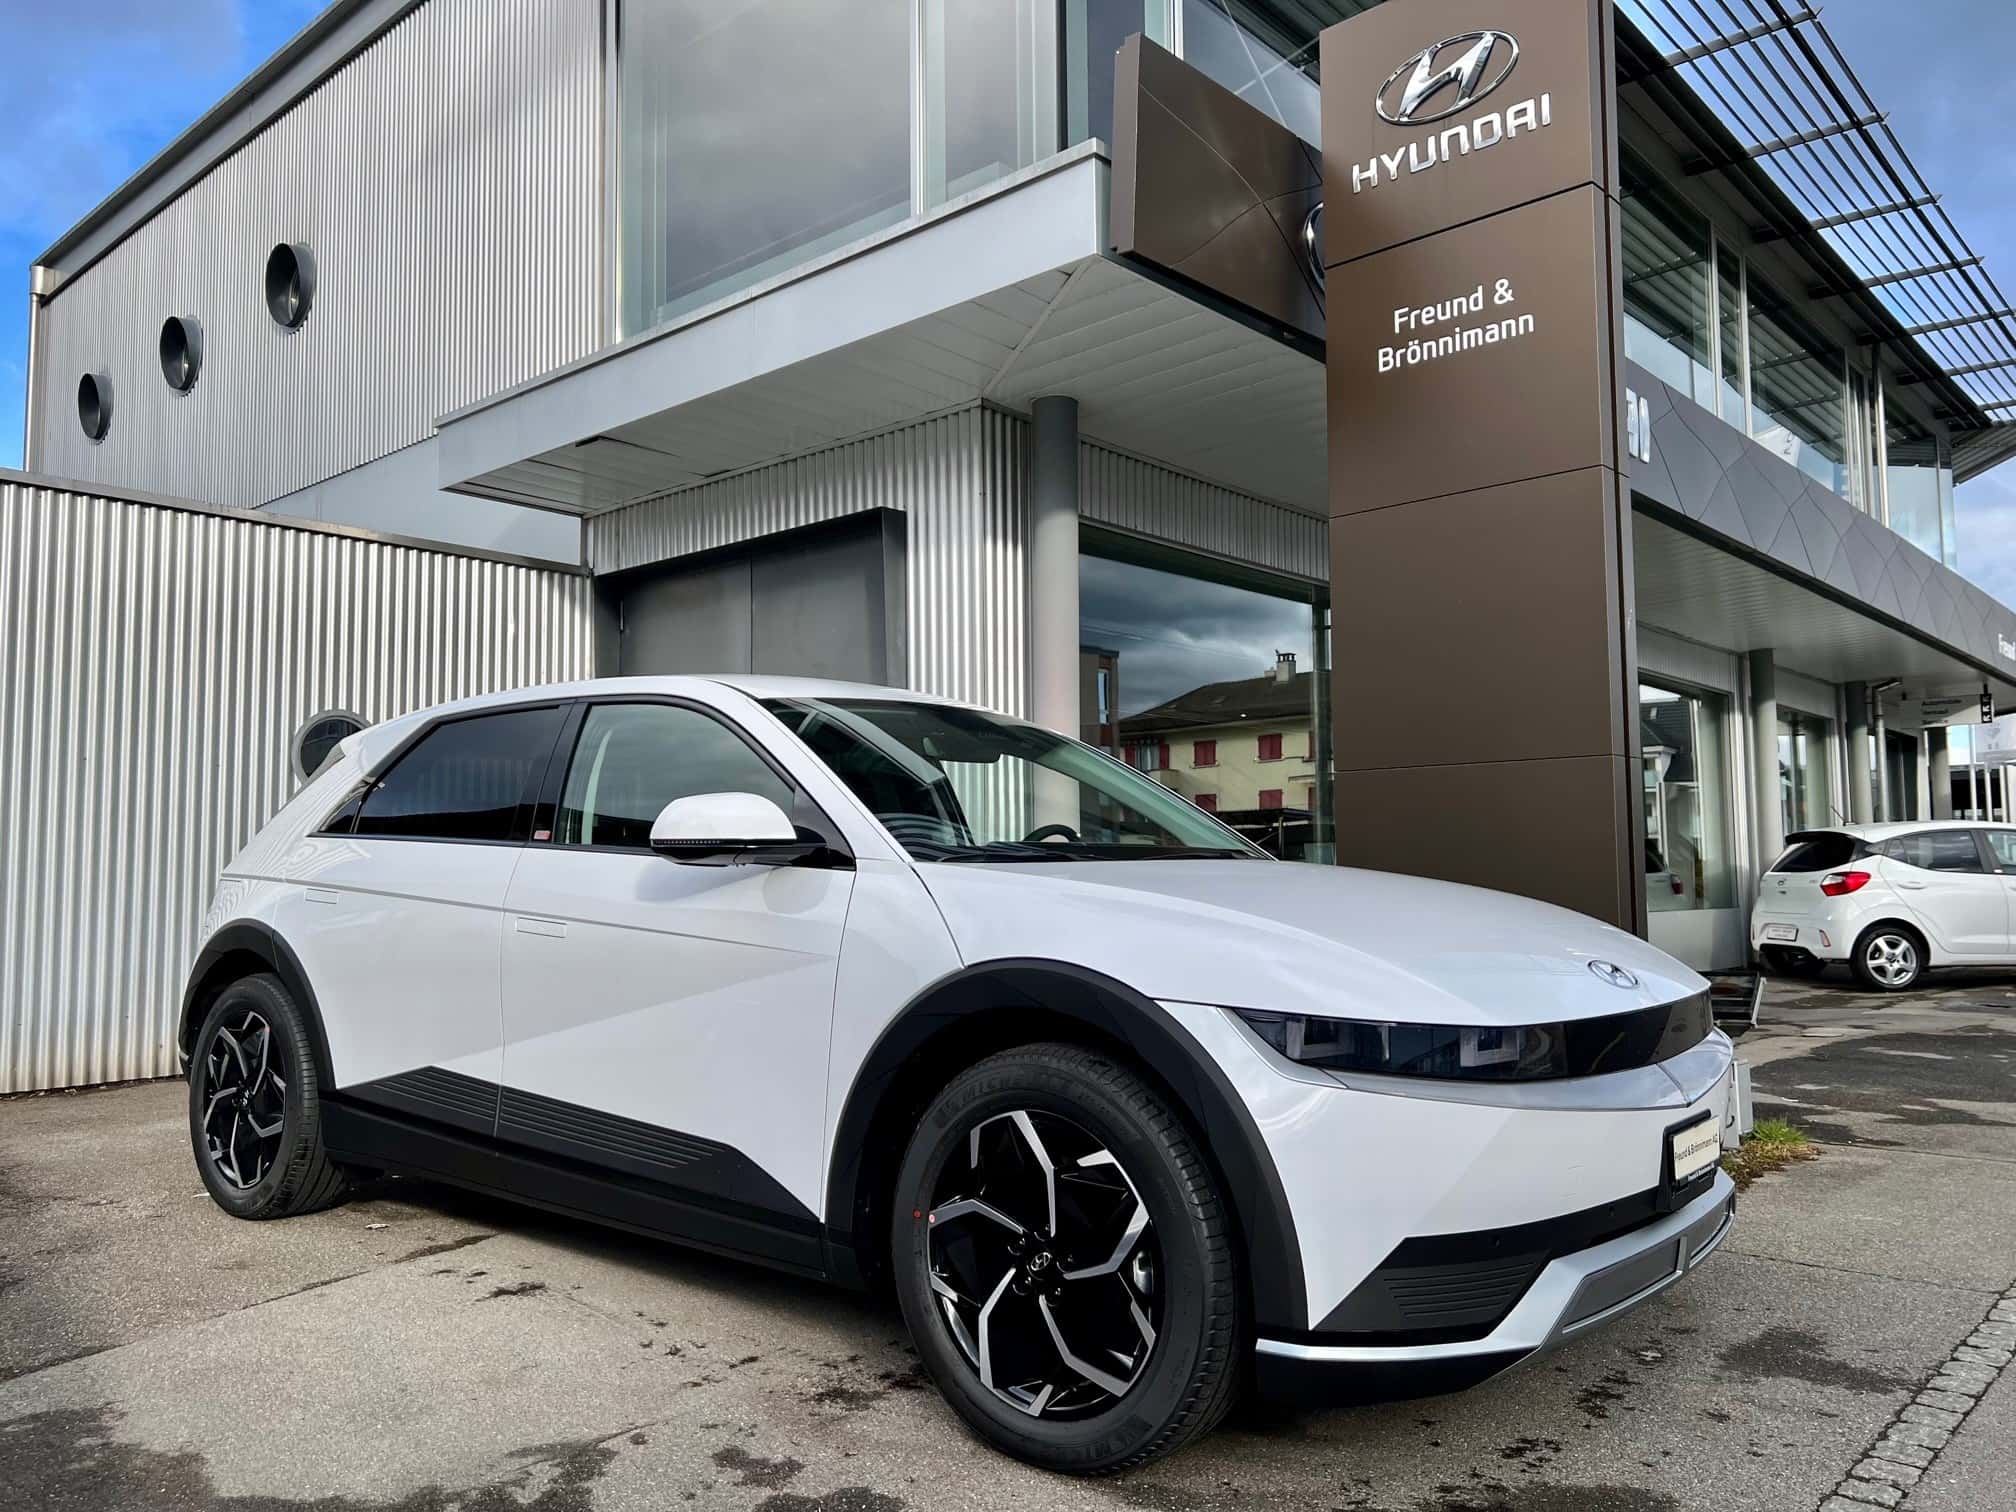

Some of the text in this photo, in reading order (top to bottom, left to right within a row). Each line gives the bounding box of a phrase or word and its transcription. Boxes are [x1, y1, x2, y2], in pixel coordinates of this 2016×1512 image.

[1352, 93, 1551, 193] HYUNDAI
[1394, 278, 1515, 333] Freund &
[1378, 314, 1534, 373] Brönnimann
